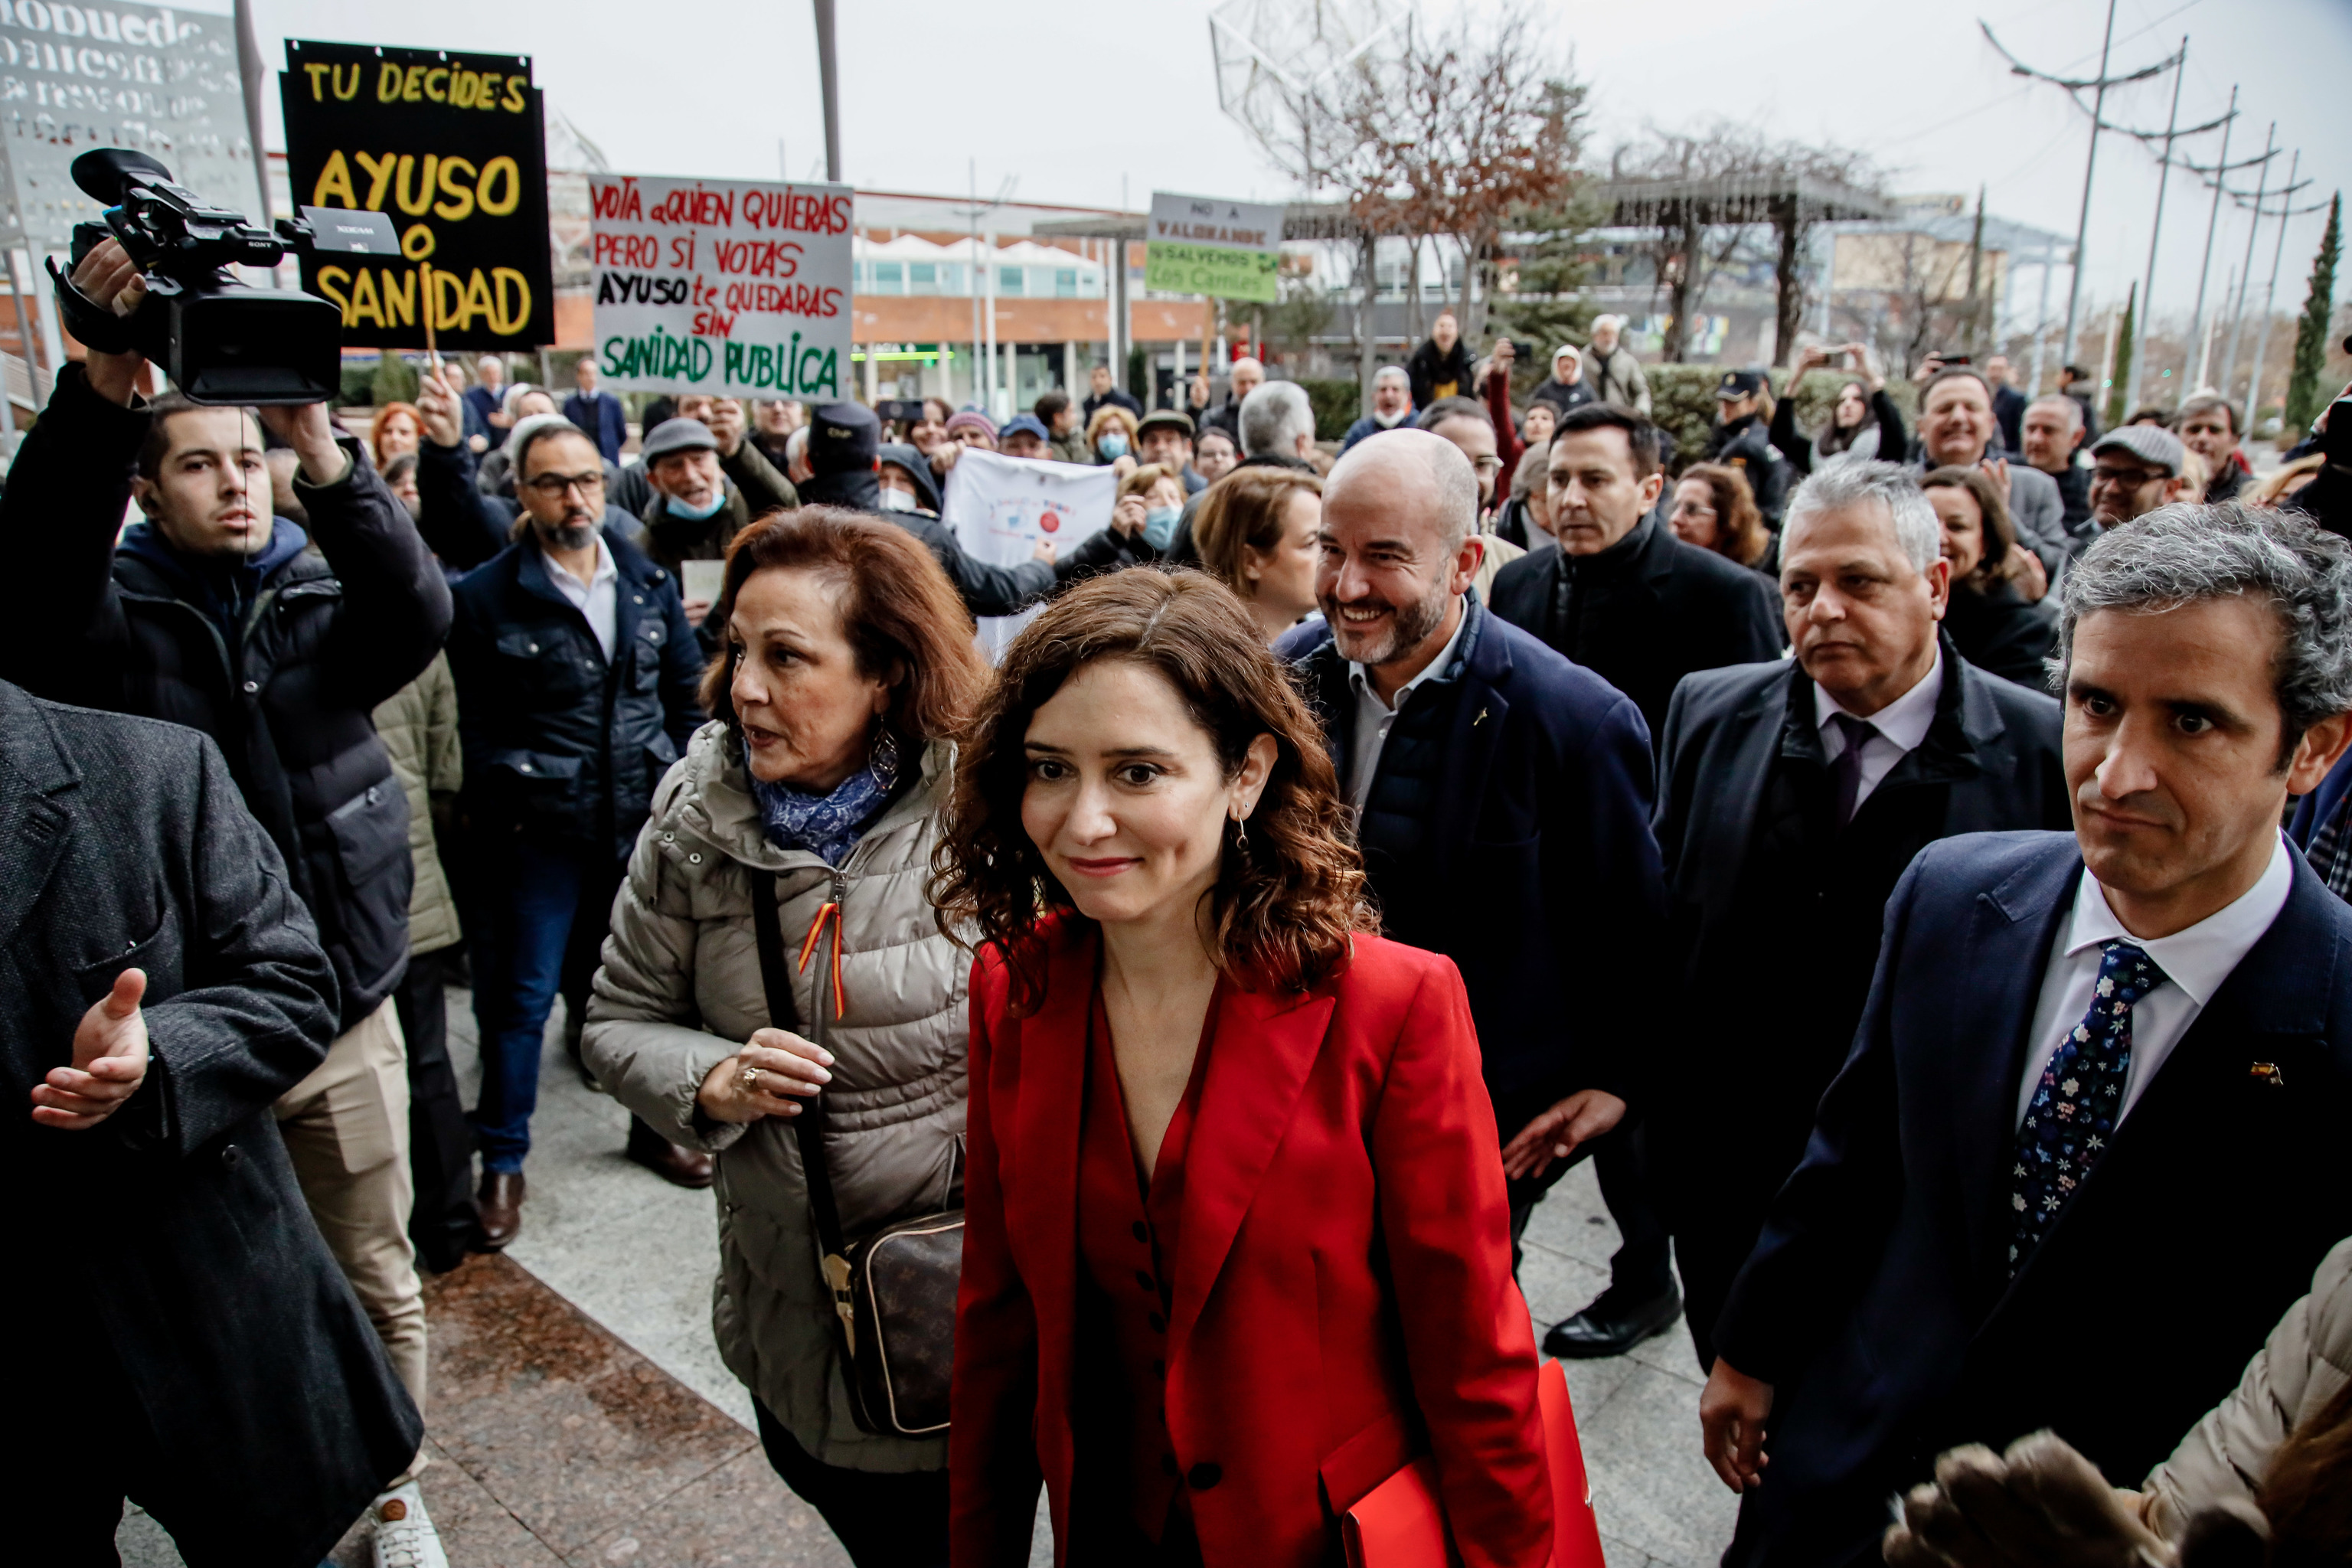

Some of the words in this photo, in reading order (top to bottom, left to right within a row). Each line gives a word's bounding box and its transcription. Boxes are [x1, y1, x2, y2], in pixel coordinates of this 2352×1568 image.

[303, 62, 361, 103] TU
[377, 60, 528, 114] DECIDES
[312, 149, 521, 220] AYUSO
[590, 176, 642, 222] VOTA
[742, 185, 852, 236] QUIERAS
[401, 223, 436, 262] O
[593, 232, 659, 269] PERO
[669, 230, 696, 271] SI
[714, 239, 804, 278] VOTAS
[316, 261, 532, 335] SANIDAD
[597, 271, 688, 305] AYUSO
[692, 274, 720, 308] te
[724, 281, 844, 318] QUEDARAS
[691, 307, 735, 338] SIN
[601, 323, 714, 382] SANIDAD
[724, 331, 838, 398] PUBLICA
